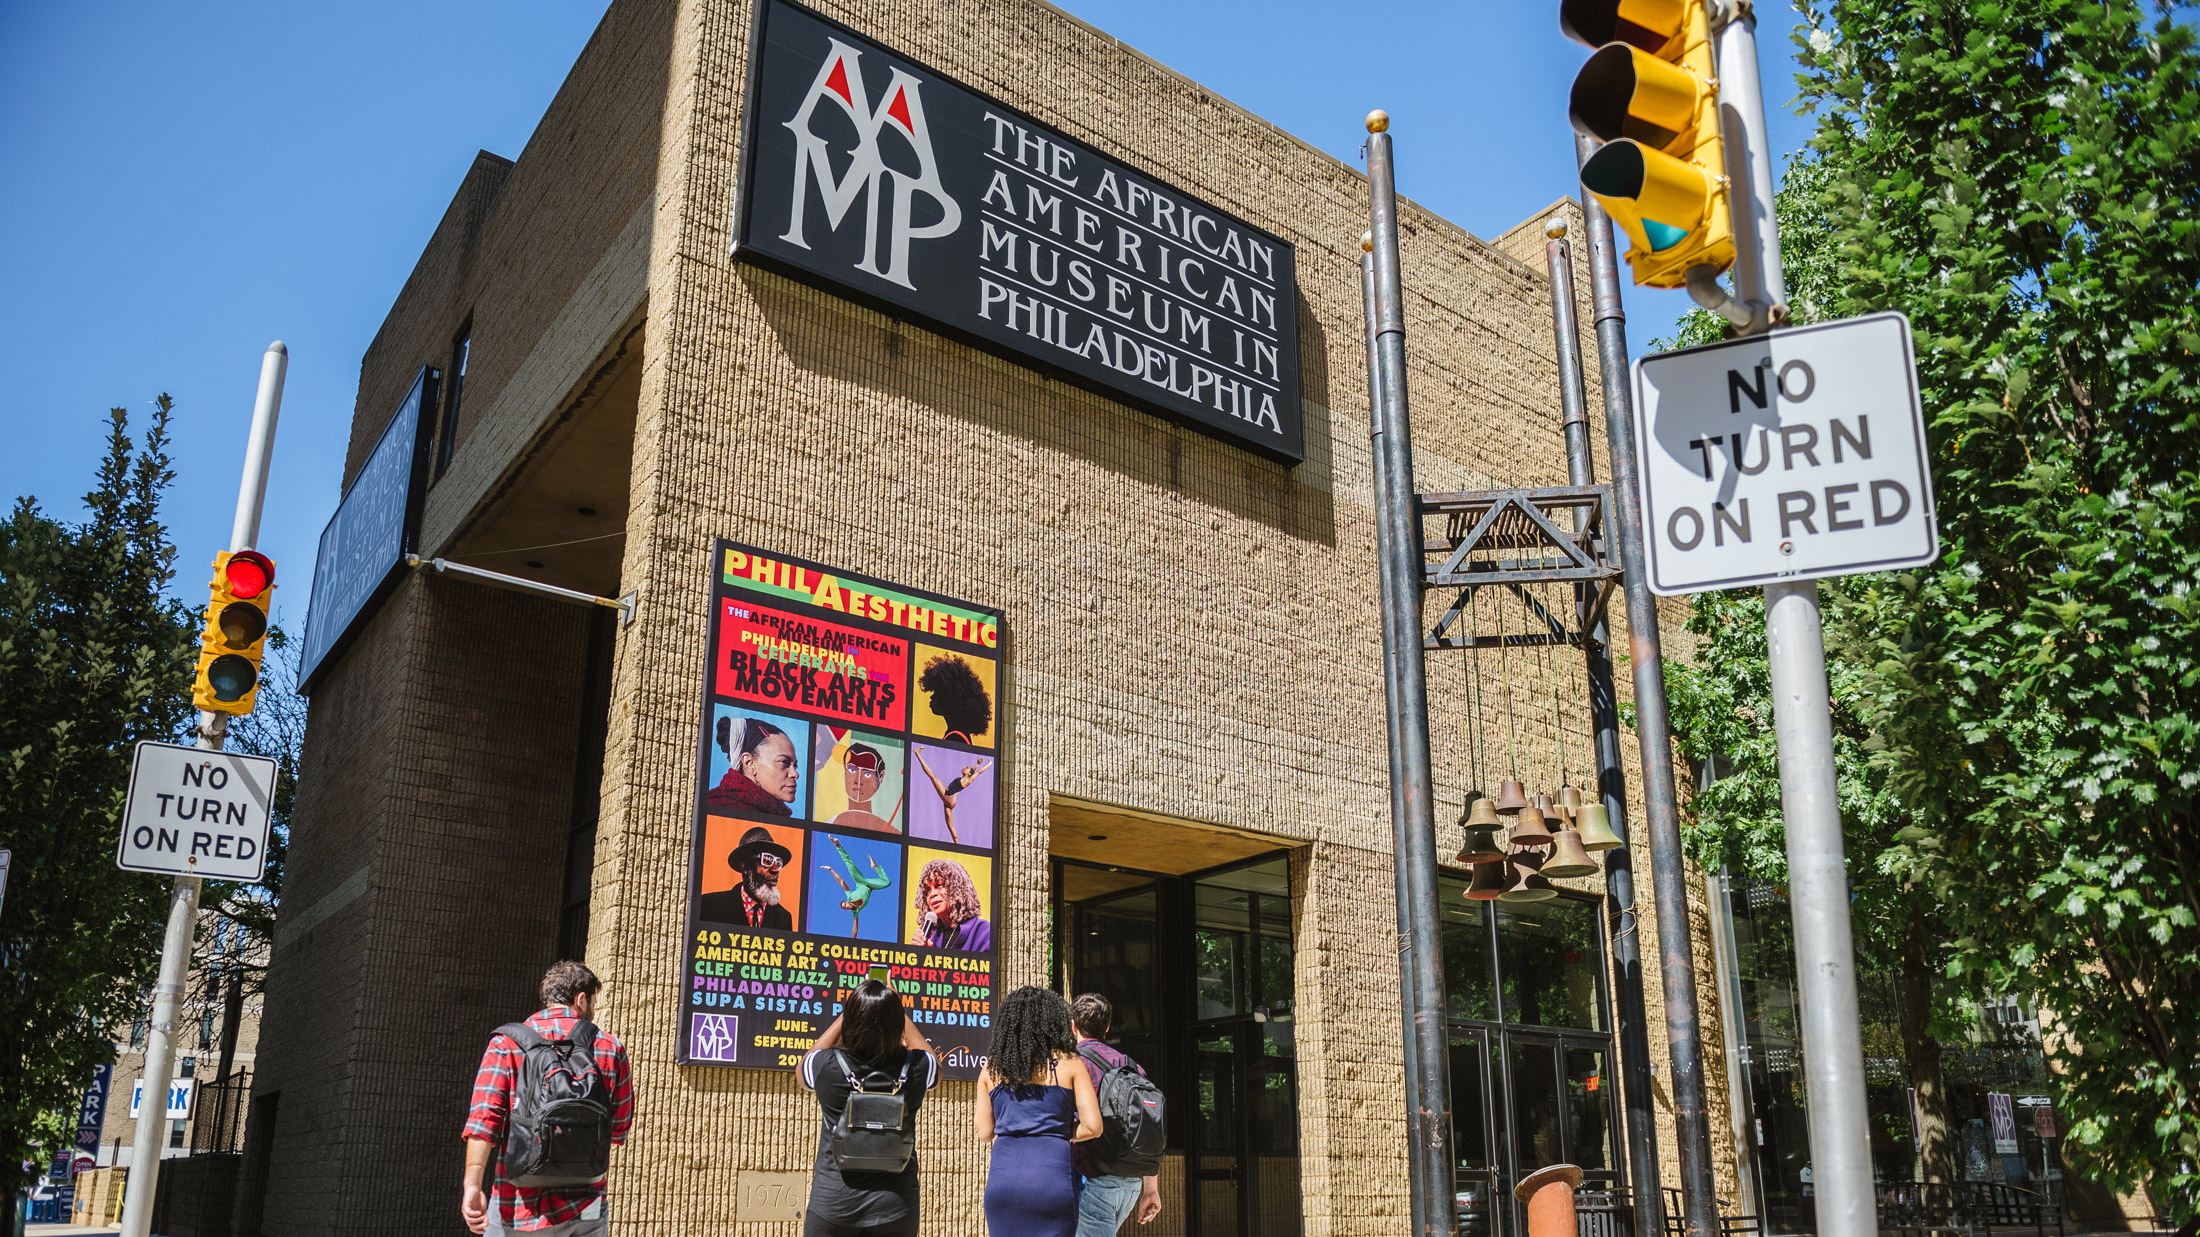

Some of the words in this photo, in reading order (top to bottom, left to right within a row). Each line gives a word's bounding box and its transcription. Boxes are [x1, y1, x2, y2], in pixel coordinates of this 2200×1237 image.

[983, 111, 1079, 188] THE
[1093, 169, 1274, 282] AFRICAN
[981, 170, 1276, 331] AMERICAN
[979, 219, 1211, 354] MUSEUM
[1234, 331, 1280, 382] IN
[978, 277, 1283, 435] PHILADELPHIA
[1727, 359, 1815, 413] NO
[351, 468, 370, 515] THE
[370, 390, 418, 487] AFRICAN
[1690, 414, 1872, 482] TURN
[343, 433, 412, 557] AMERICAN
[1667, 498, 1752, 551] ON
[1778, 480, 1911, 538] RED
[337, 505, 387, 597] MUSEUM
[331, 525, 398, 638] PHILADELPHIA
[727, 606, 749, 619] THE
[749, 612, 818, 637] AFRICAN
[823, 629, 901, 657] AMERICAN
[741, 630, 857, 666] PHILADELPHIA
[777, 628, 844, 653] MUSEUM
[847, 646, 859, 656] IN
[730, 649, 818, 688] BLACK
[828, 671, 896, 704] ARTS
[757, 645, 868, 680] CELEBRATES
[869, 671, 889, 683] THE
[735, 670, 890, 720] MOVEMENT
[182, 763, 228, 790] NO
[156, 793, 247, 826] TURN
[133, 826, 180, 853] ON
[191, 832, 256, 860] RED
[694, 945, 782, 967] AMERICAN
[786, 955, 818, 970] ART
[834, 959, 873, 976] YOU
[891, 965, 948, 983] POETRY
[952, 972, 990, 987] SLAM
[697, 930, 721, 945] 40
[728, 933, 786, 952] YEARS
[791, 940, 814, 955] OF
[821, 943, 918, 966] COLLECTING
[923, 954, 990, 973] AFRICAN
[693, 976, 815, 999] PHILADANCO
[921, 996, 990, 1013] THEATRE
[694, 961, 734, 977] CLEF
[740, 965, 783, 981] CLUB
[788, 970, 833, 988] JAZZ,
[926, 983, 953, 998] HIP
[958, 986, 990, 1000] HOP
[692, 991, 746, 1009] SUPA
[755, 997, 823, 1015] SISTAS
[912, 1010, 991, 1028] READING
[754, 1035, 819, 1050] SEPTEMB
[778, 1054, 804, 1066] 201
[948, 1050, 988, 1068] alive
[83, 1064, 106, 1125] PARK
[133, 1087, 190, 1110] PRK
[746, 1184, 799, 1208] 1976
